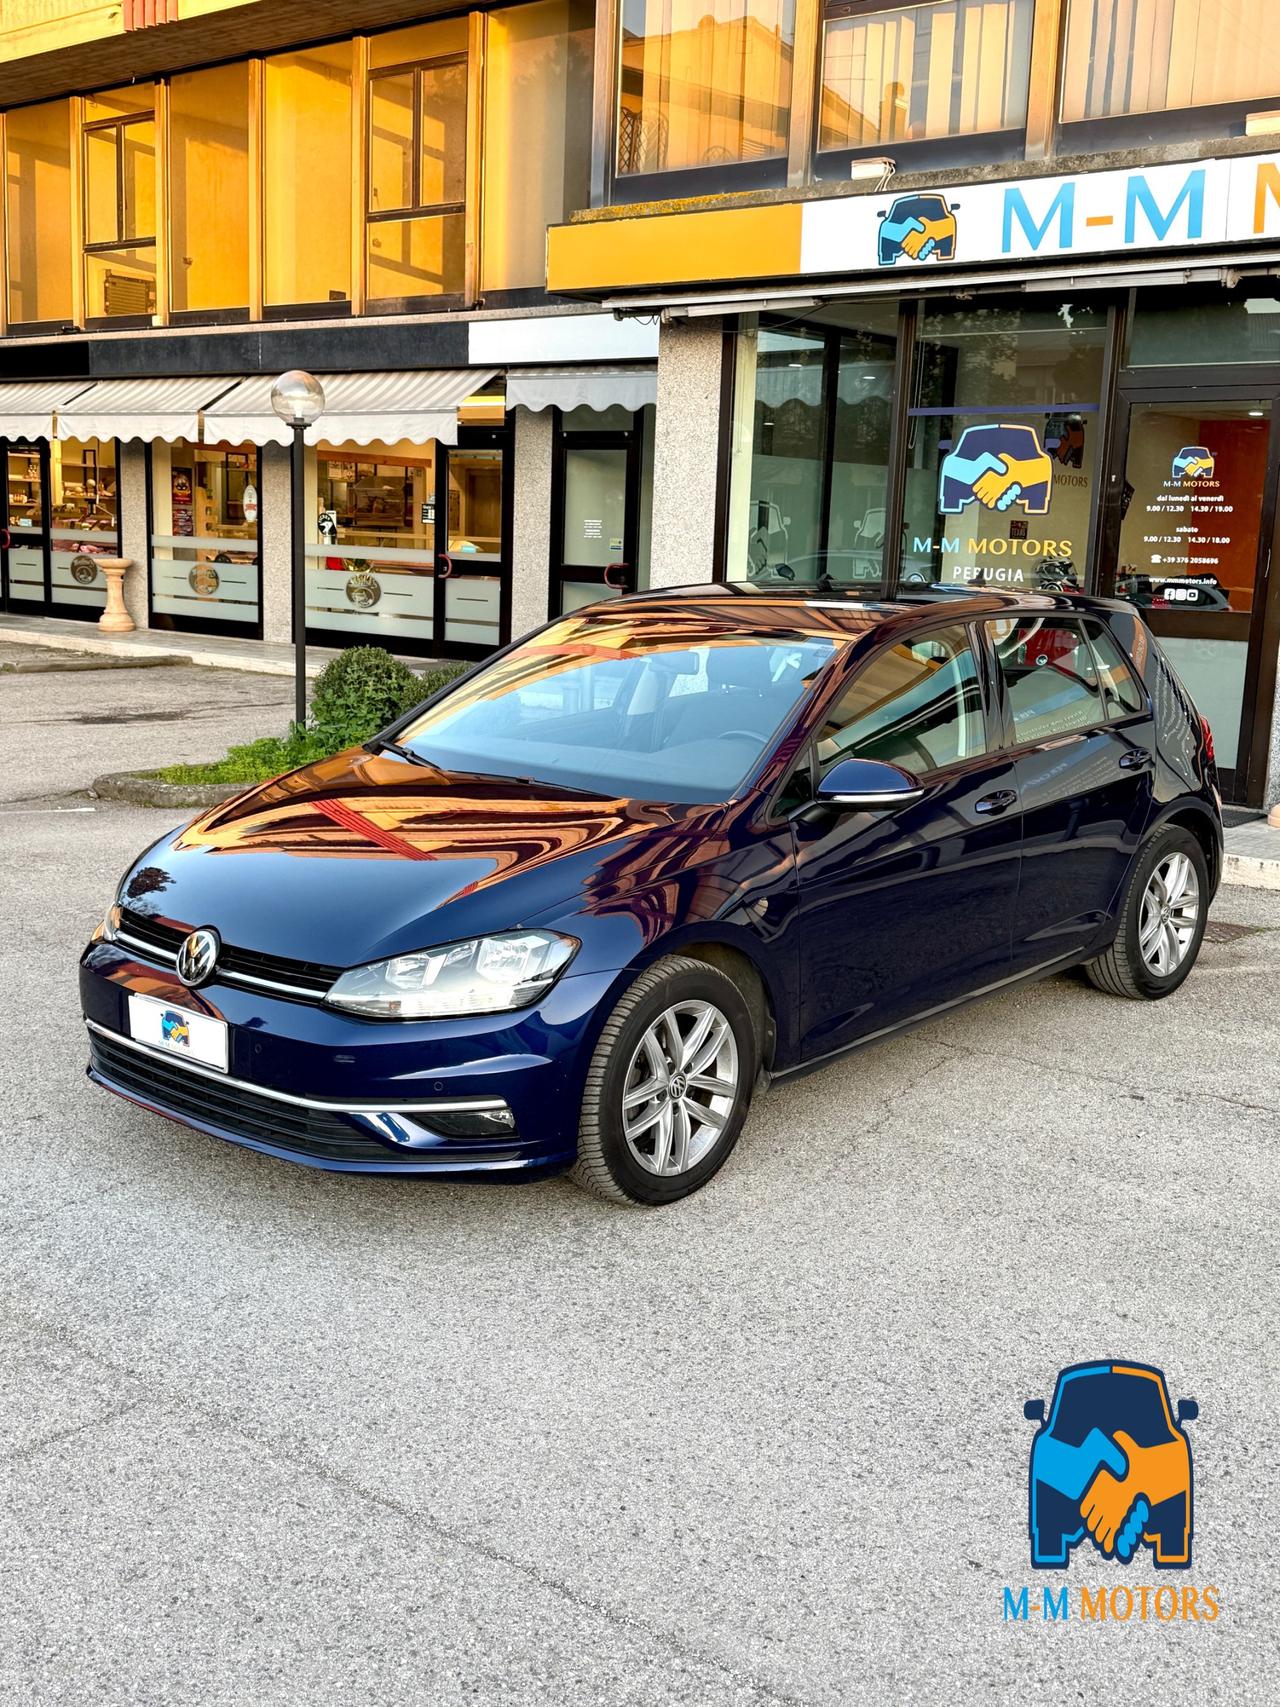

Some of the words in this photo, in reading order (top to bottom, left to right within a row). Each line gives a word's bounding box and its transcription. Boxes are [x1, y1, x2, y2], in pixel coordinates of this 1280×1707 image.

[1001, 169, 1206, 253] M-M
[1215, 505, 1234, 513] 19.00
[913, 537, 960, 553] M-M
[968, 538, 1073, 557] MOTORS
[952, 566, 1024, 583] PERUGIA
